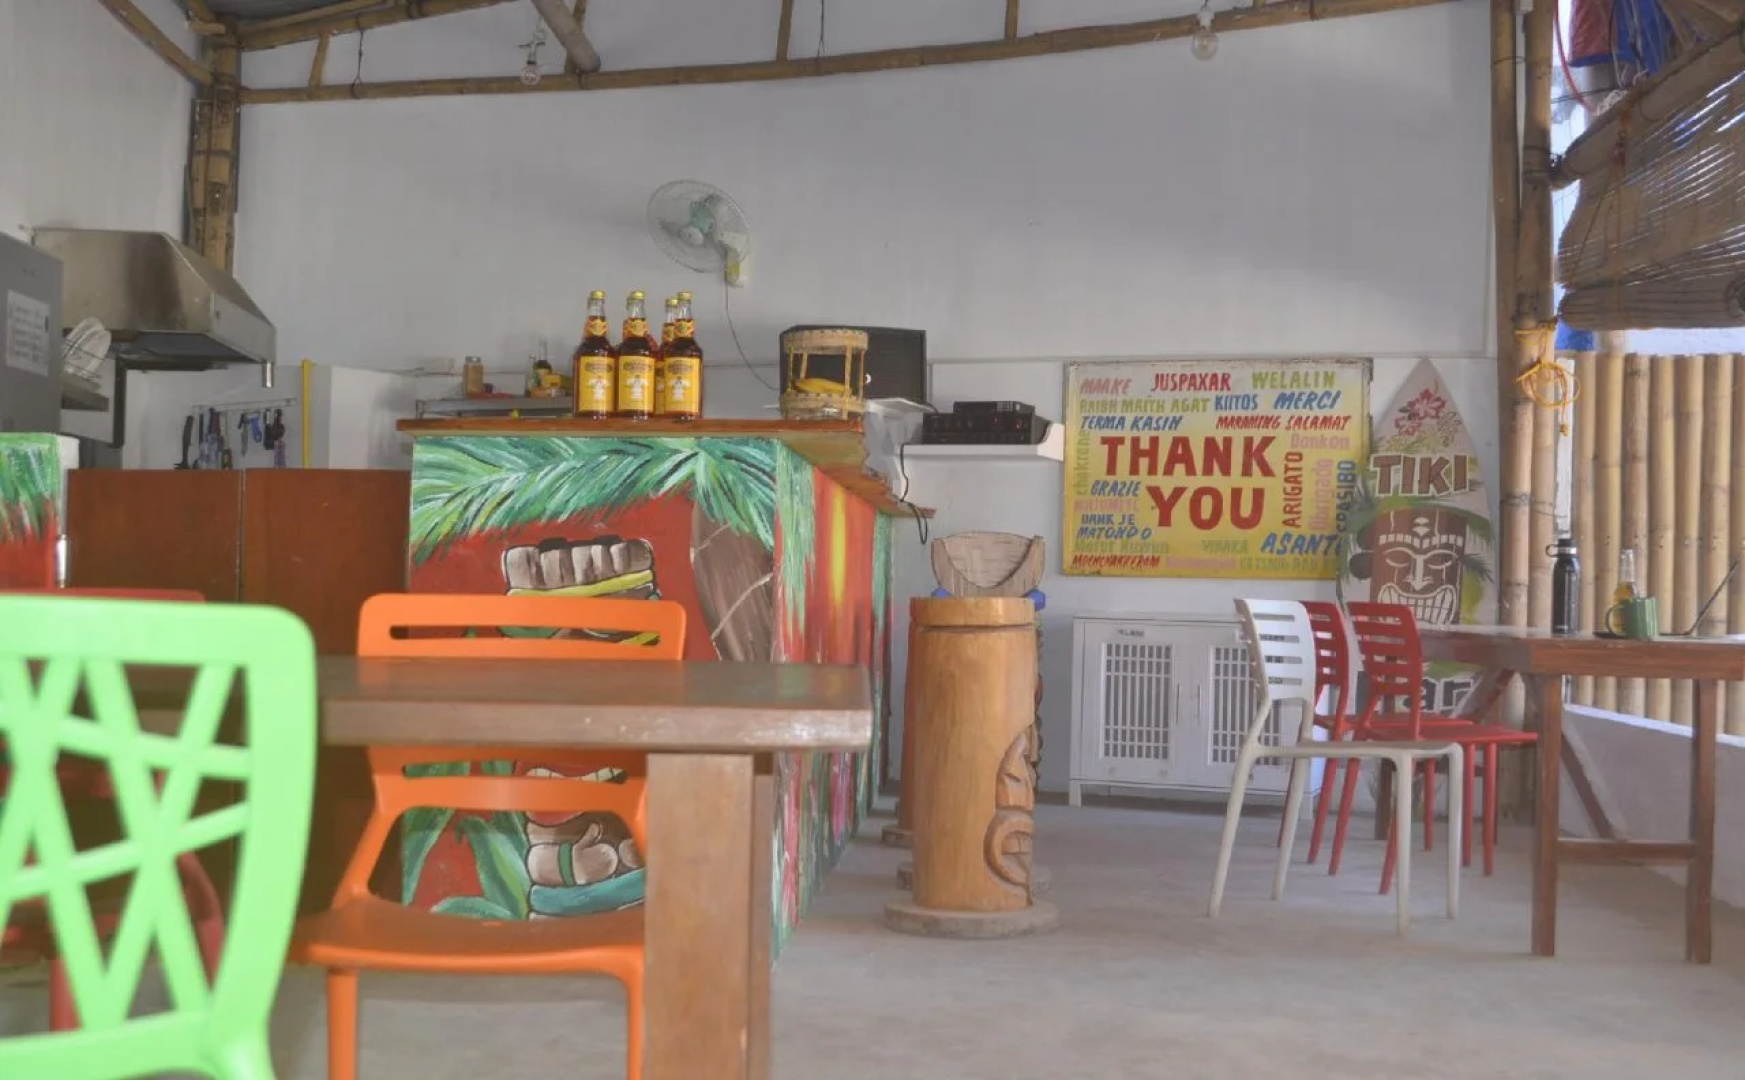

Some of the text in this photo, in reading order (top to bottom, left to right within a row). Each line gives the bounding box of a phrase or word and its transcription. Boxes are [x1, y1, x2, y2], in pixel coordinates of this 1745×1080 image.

[1150, 373, 1231, 391] JUSPAXAR
[1251, 370, 1336, 390] WELALIN
[1273, 390, 1341, 411] MERCI
[1101, 435, 1277, 477] THANK
[1370, 452, 1469, 496] TIKI
[1091, 480, 1141, 497] GRAZIE
[1282, 451, 1303, 529] ARIGATO
[1145, 485, 1265, 530] YOU
[1118, 513, 1135, 526] JE
